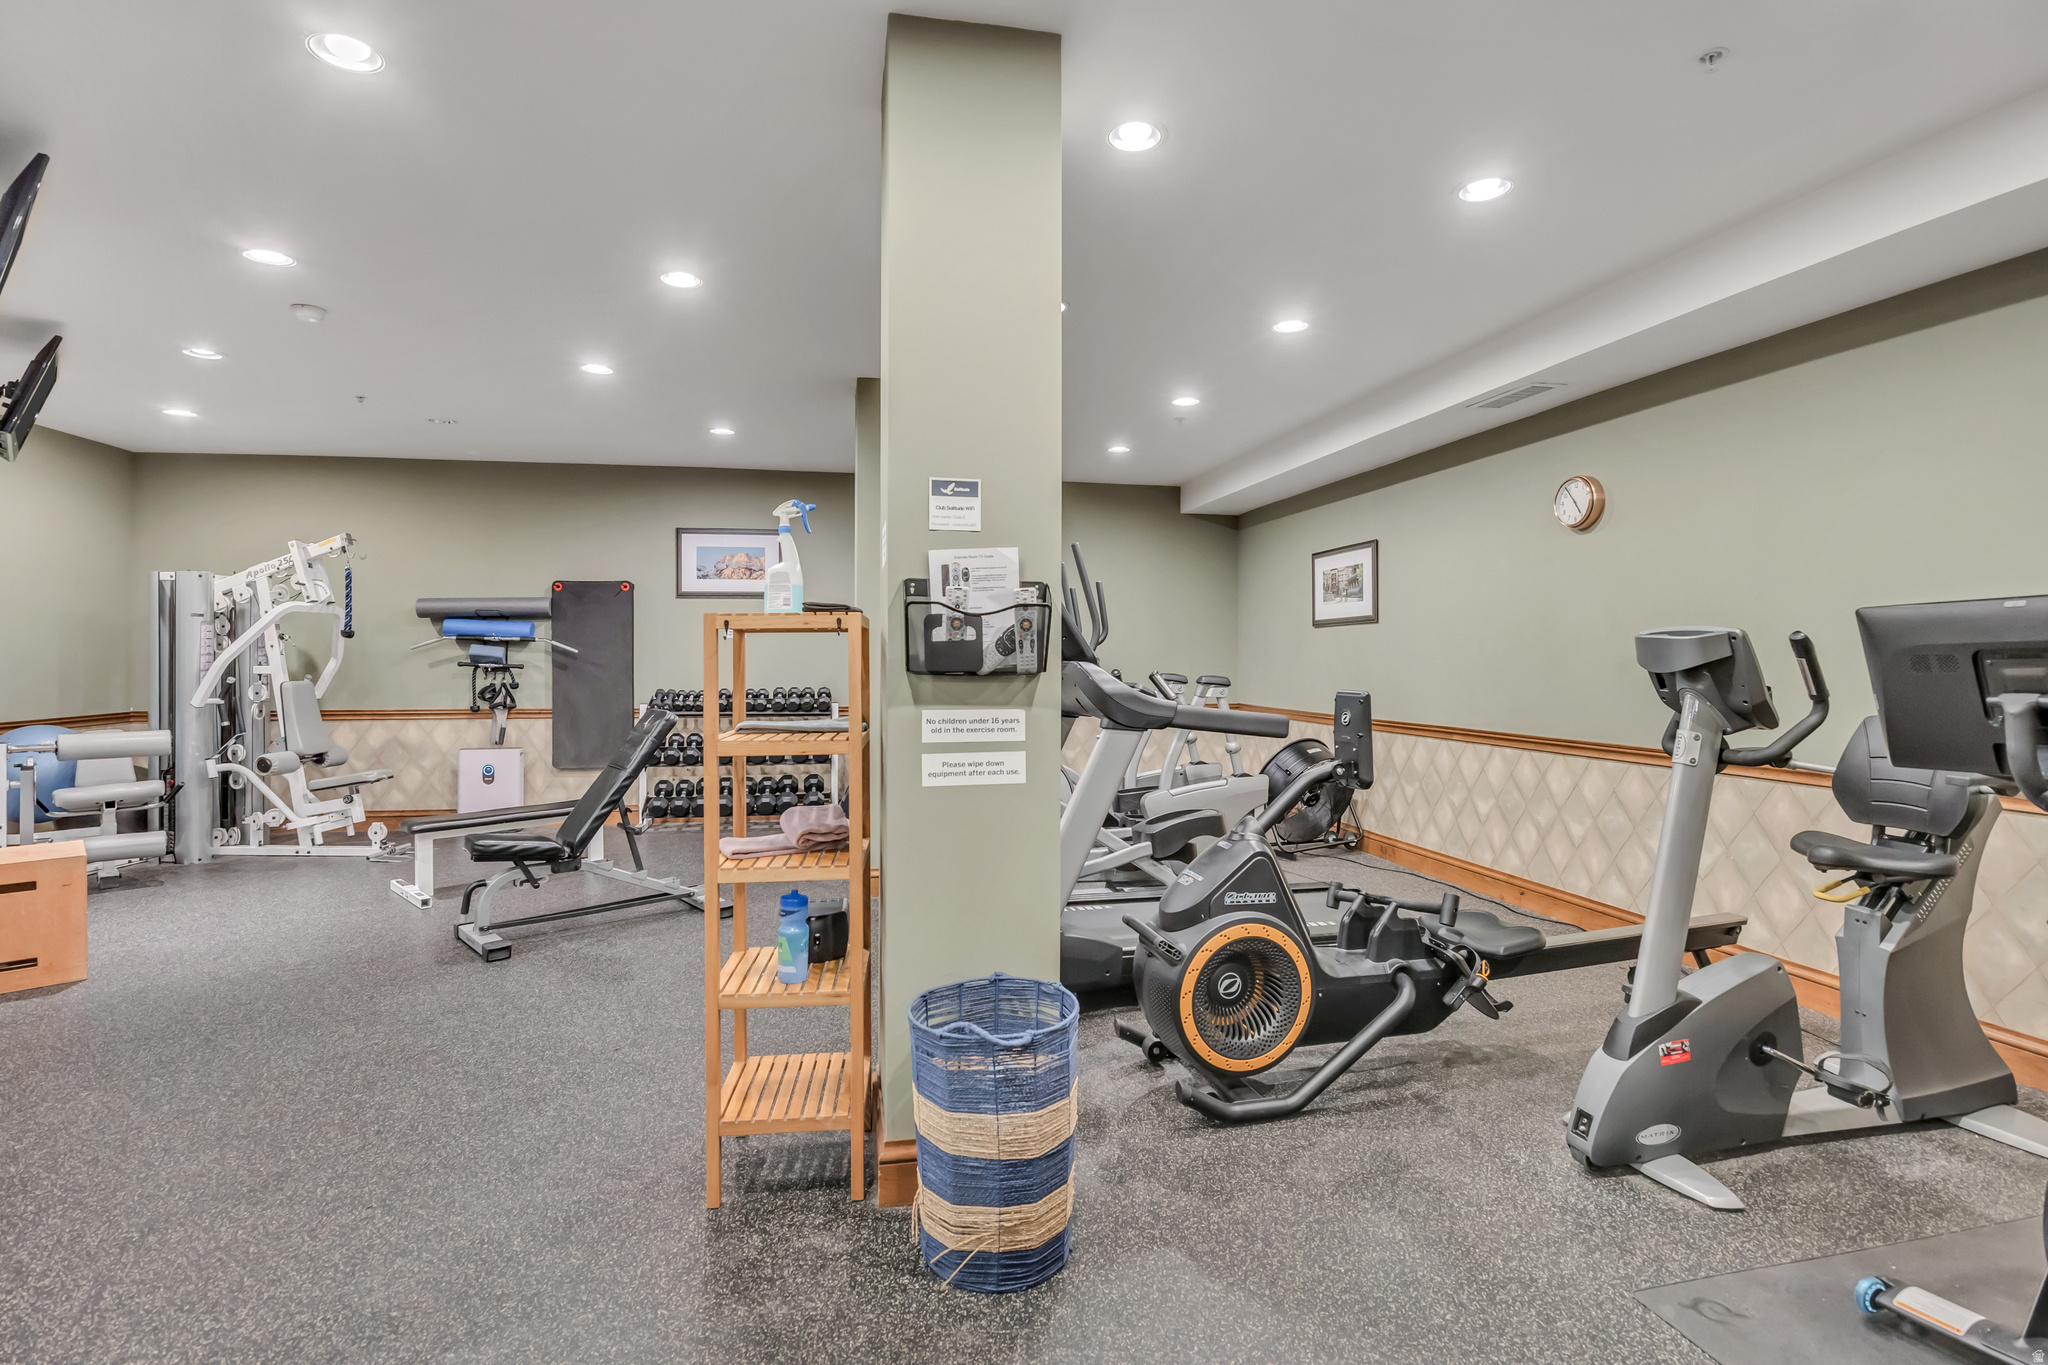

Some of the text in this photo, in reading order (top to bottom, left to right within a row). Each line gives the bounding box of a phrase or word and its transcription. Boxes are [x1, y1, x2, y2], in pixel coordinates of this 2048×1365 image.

[246, 563, 276, 579] Apollo
[927, 770, 967, 778] equipment
[1641, 1130, 1675, 1139] MATRIX
